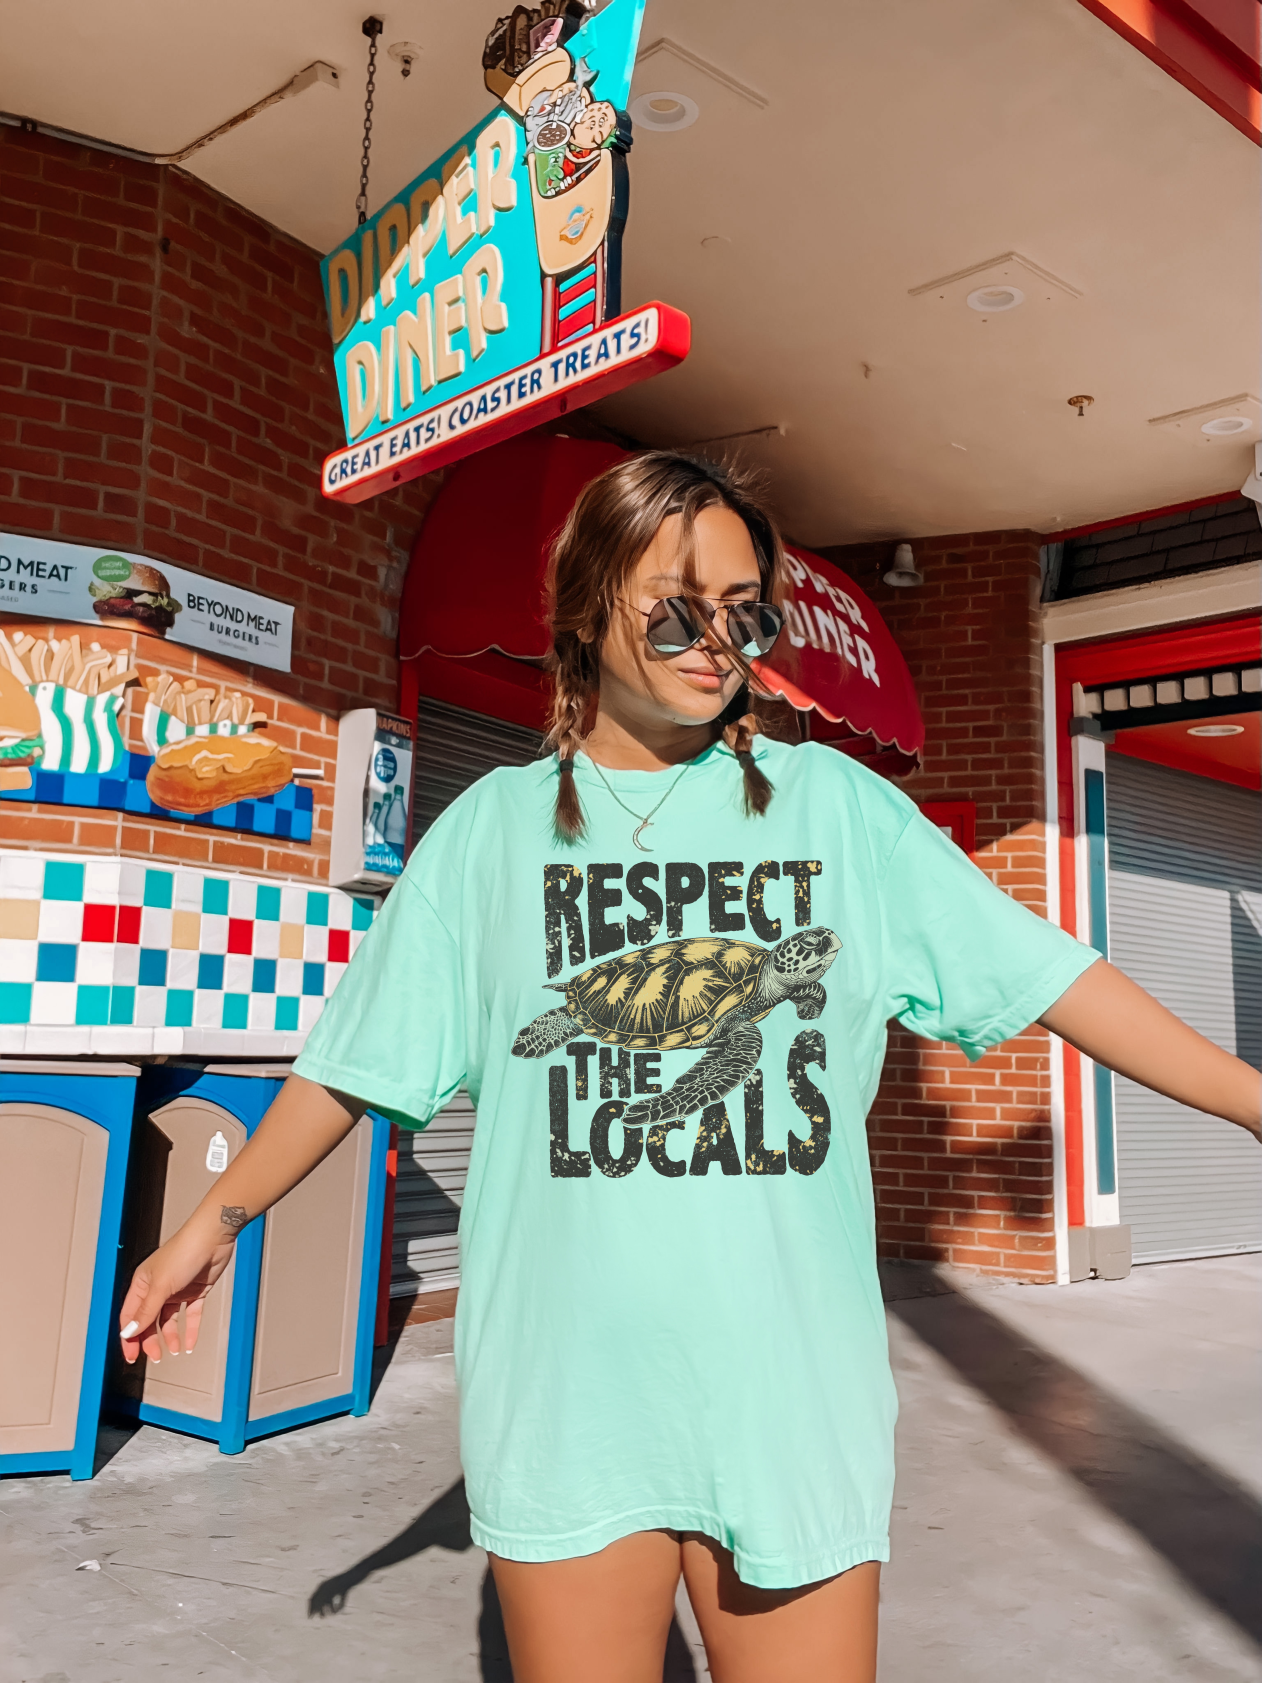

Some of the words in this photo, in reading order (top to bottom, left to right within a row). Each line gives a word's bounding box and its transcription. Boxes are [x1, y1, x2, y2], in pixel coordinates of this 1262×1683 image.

[328, 117, 517, 345] DIPPER
[346, 243, 508, 440] DINER
[328, 442, 384, 486] GREAT
[389, 414, 442, 458] EATS!
[448, 367, 543, 430] COASTER
[550, 317, 650, 384] TREATS!
[16, 557, 74, 582] MEAT
[187, 592, 244, 624] BEYOND
[246, 611, 281, 636] MEAT
[209, 621, 260, 646] BURGERS
[543, 860, 823, 979] RESPECT
[548, 1028, 832, 1178] LOCALS
[566, 1041, 662, 1100] THE
